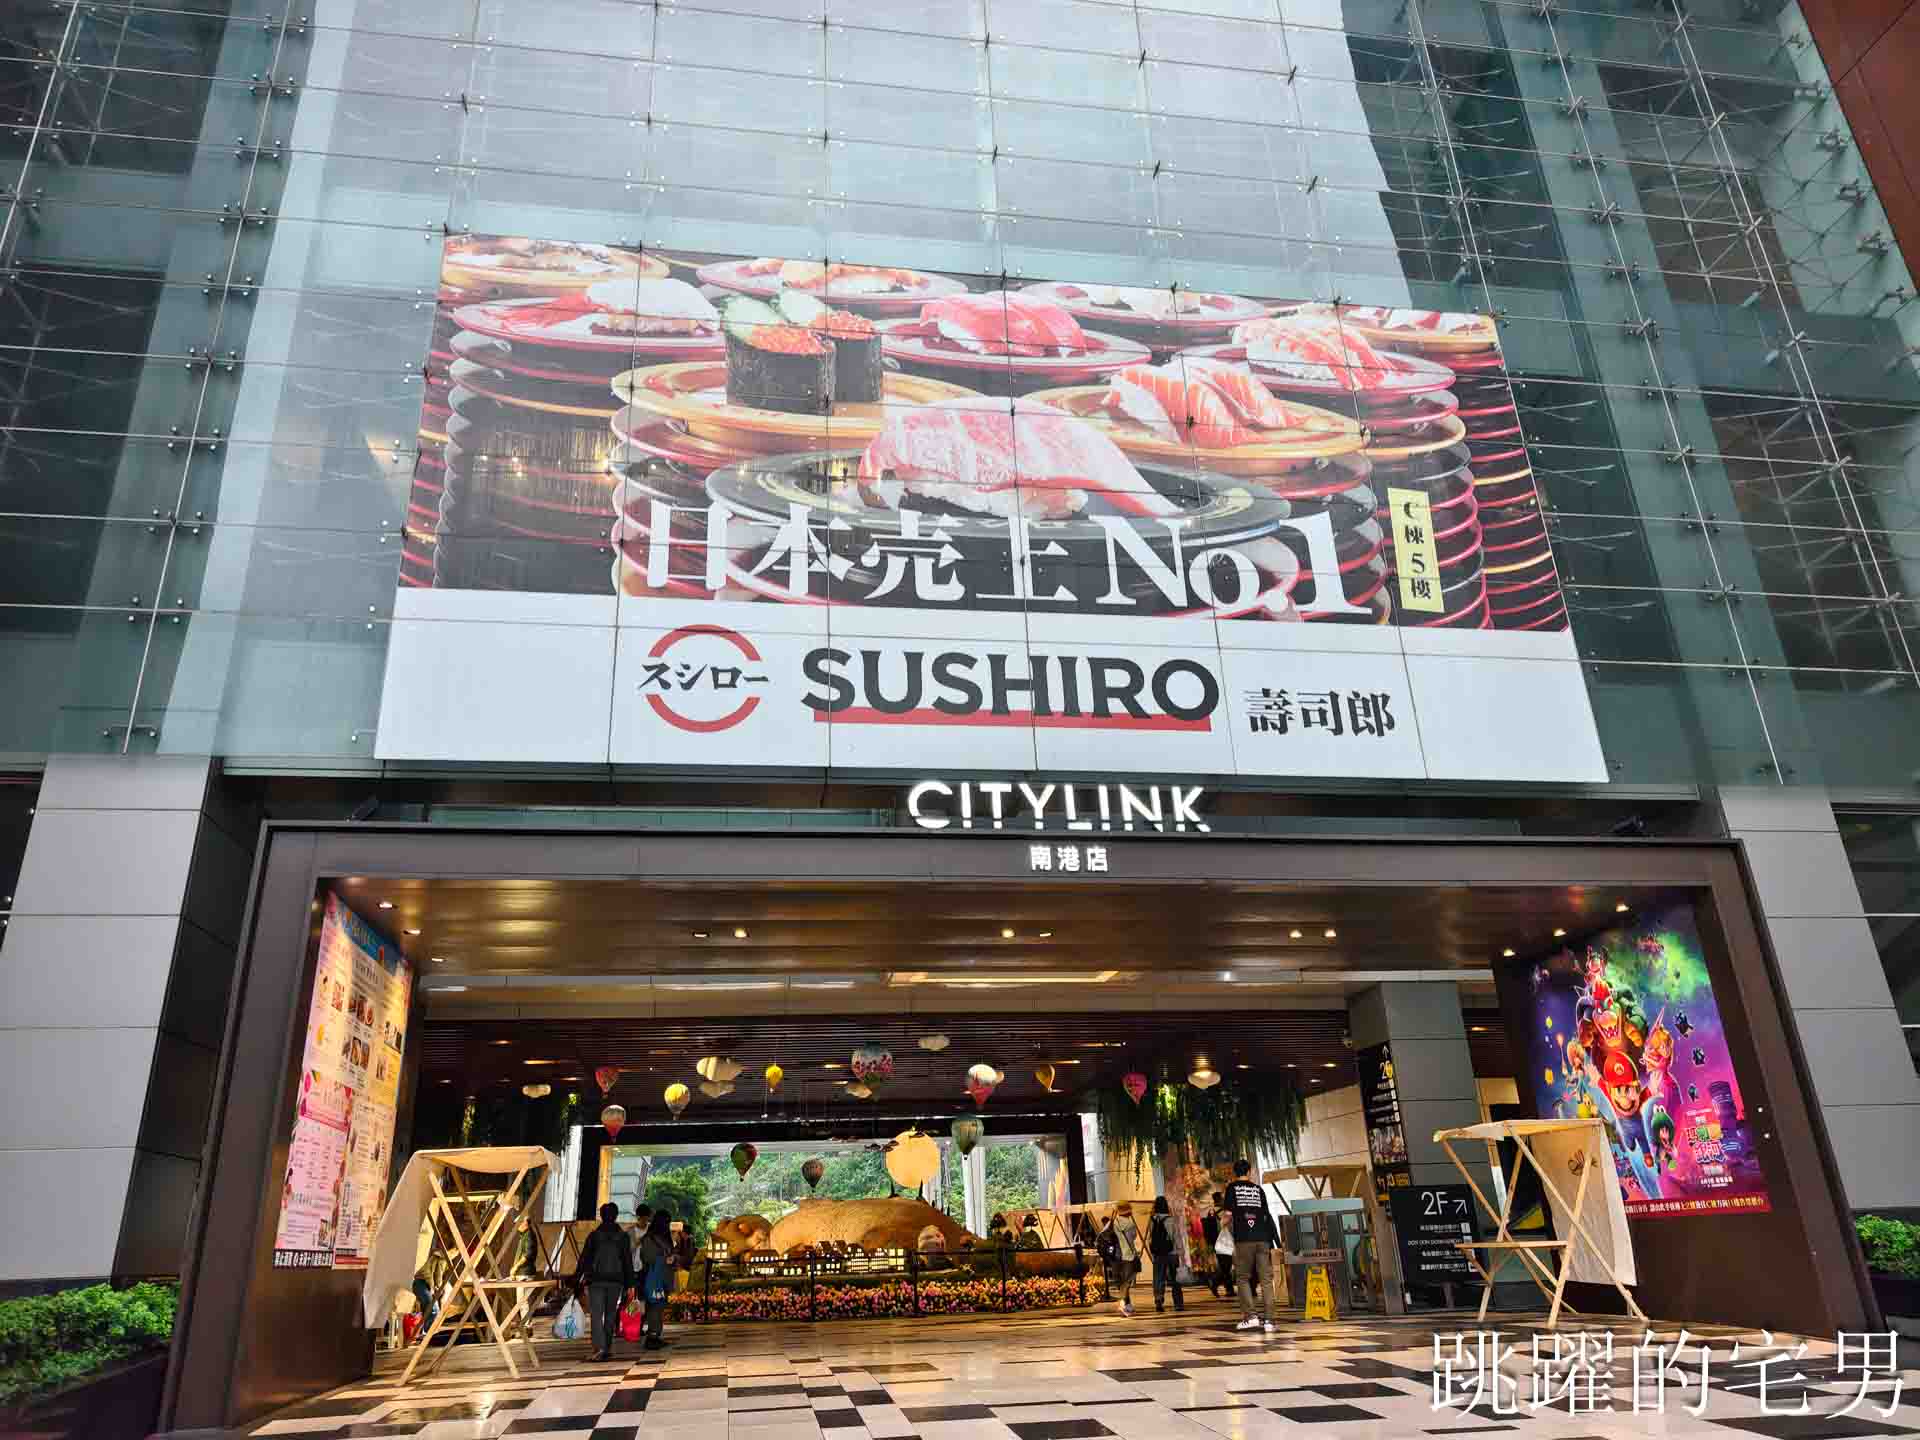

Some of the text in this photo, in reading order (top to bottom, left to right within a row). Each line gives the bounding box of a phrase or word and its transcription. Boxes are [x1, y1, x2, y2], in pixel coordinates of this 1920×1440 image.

[637, 664, 770, 692] スシロー
[801, 647, 1220, 721] SUSHIRO
[1245, 688, 1396, 738] 壽司郎
[907, 780, 1211, 832] CITYLINK
[1029, 846, 1108, 872] 南港店
[1421, 1191, 1448, 1215] 2F
